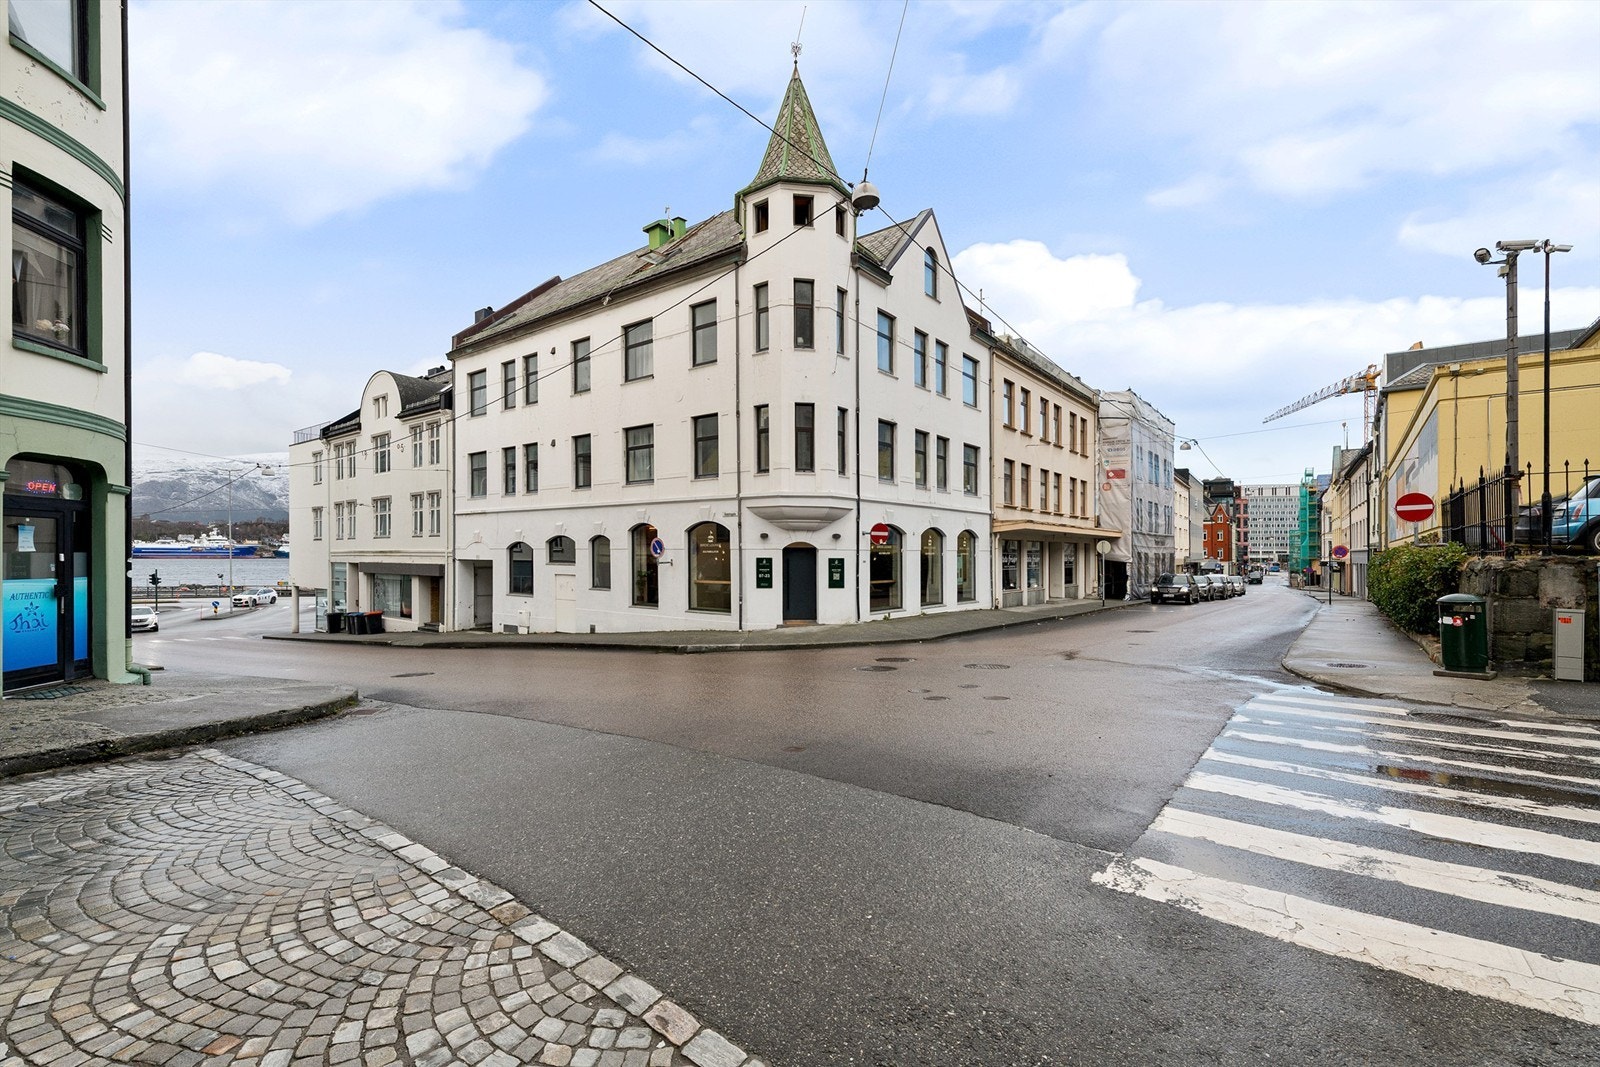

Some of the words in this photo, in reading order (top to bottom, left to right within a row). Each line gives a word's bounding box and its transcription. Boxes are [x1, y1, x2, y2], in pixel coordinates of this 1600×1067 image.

[28, 481, 56, 492] OPEN
[9, 591, 50, 600] AUTHENTIC
[9, 612, 49, 631] Thai
